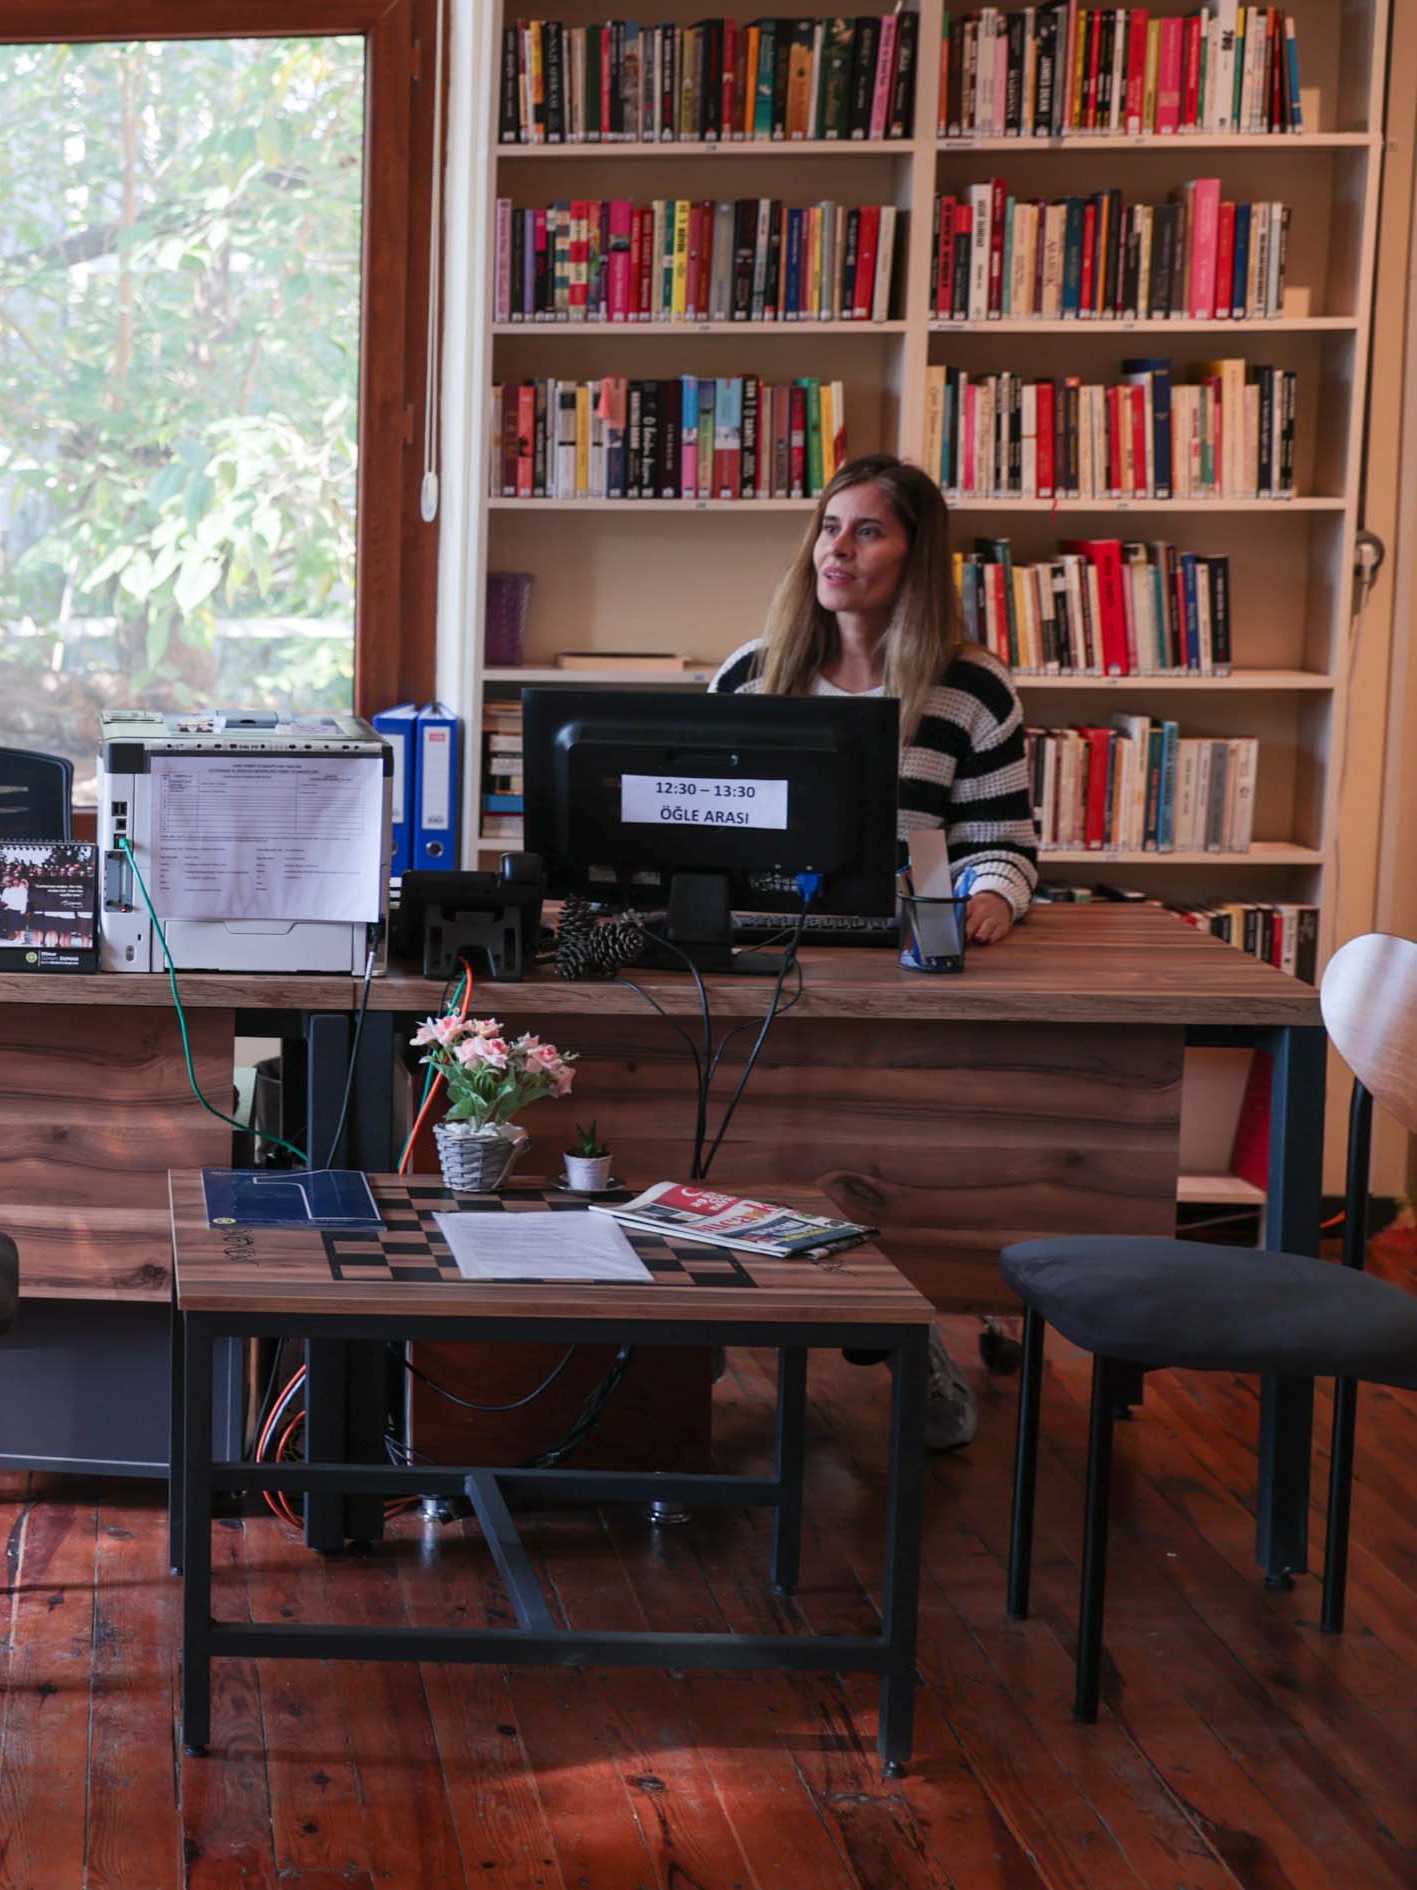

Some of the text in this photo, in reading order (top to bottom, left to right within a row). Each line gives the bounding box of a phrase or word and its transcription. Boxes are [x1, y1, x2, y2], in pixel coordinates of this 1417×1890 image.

[655, 782, 697, 795] 12:30
[714, 785, 756, 798] 13:30
[660, 805, 750, 824] ÖĞLE ARASI
